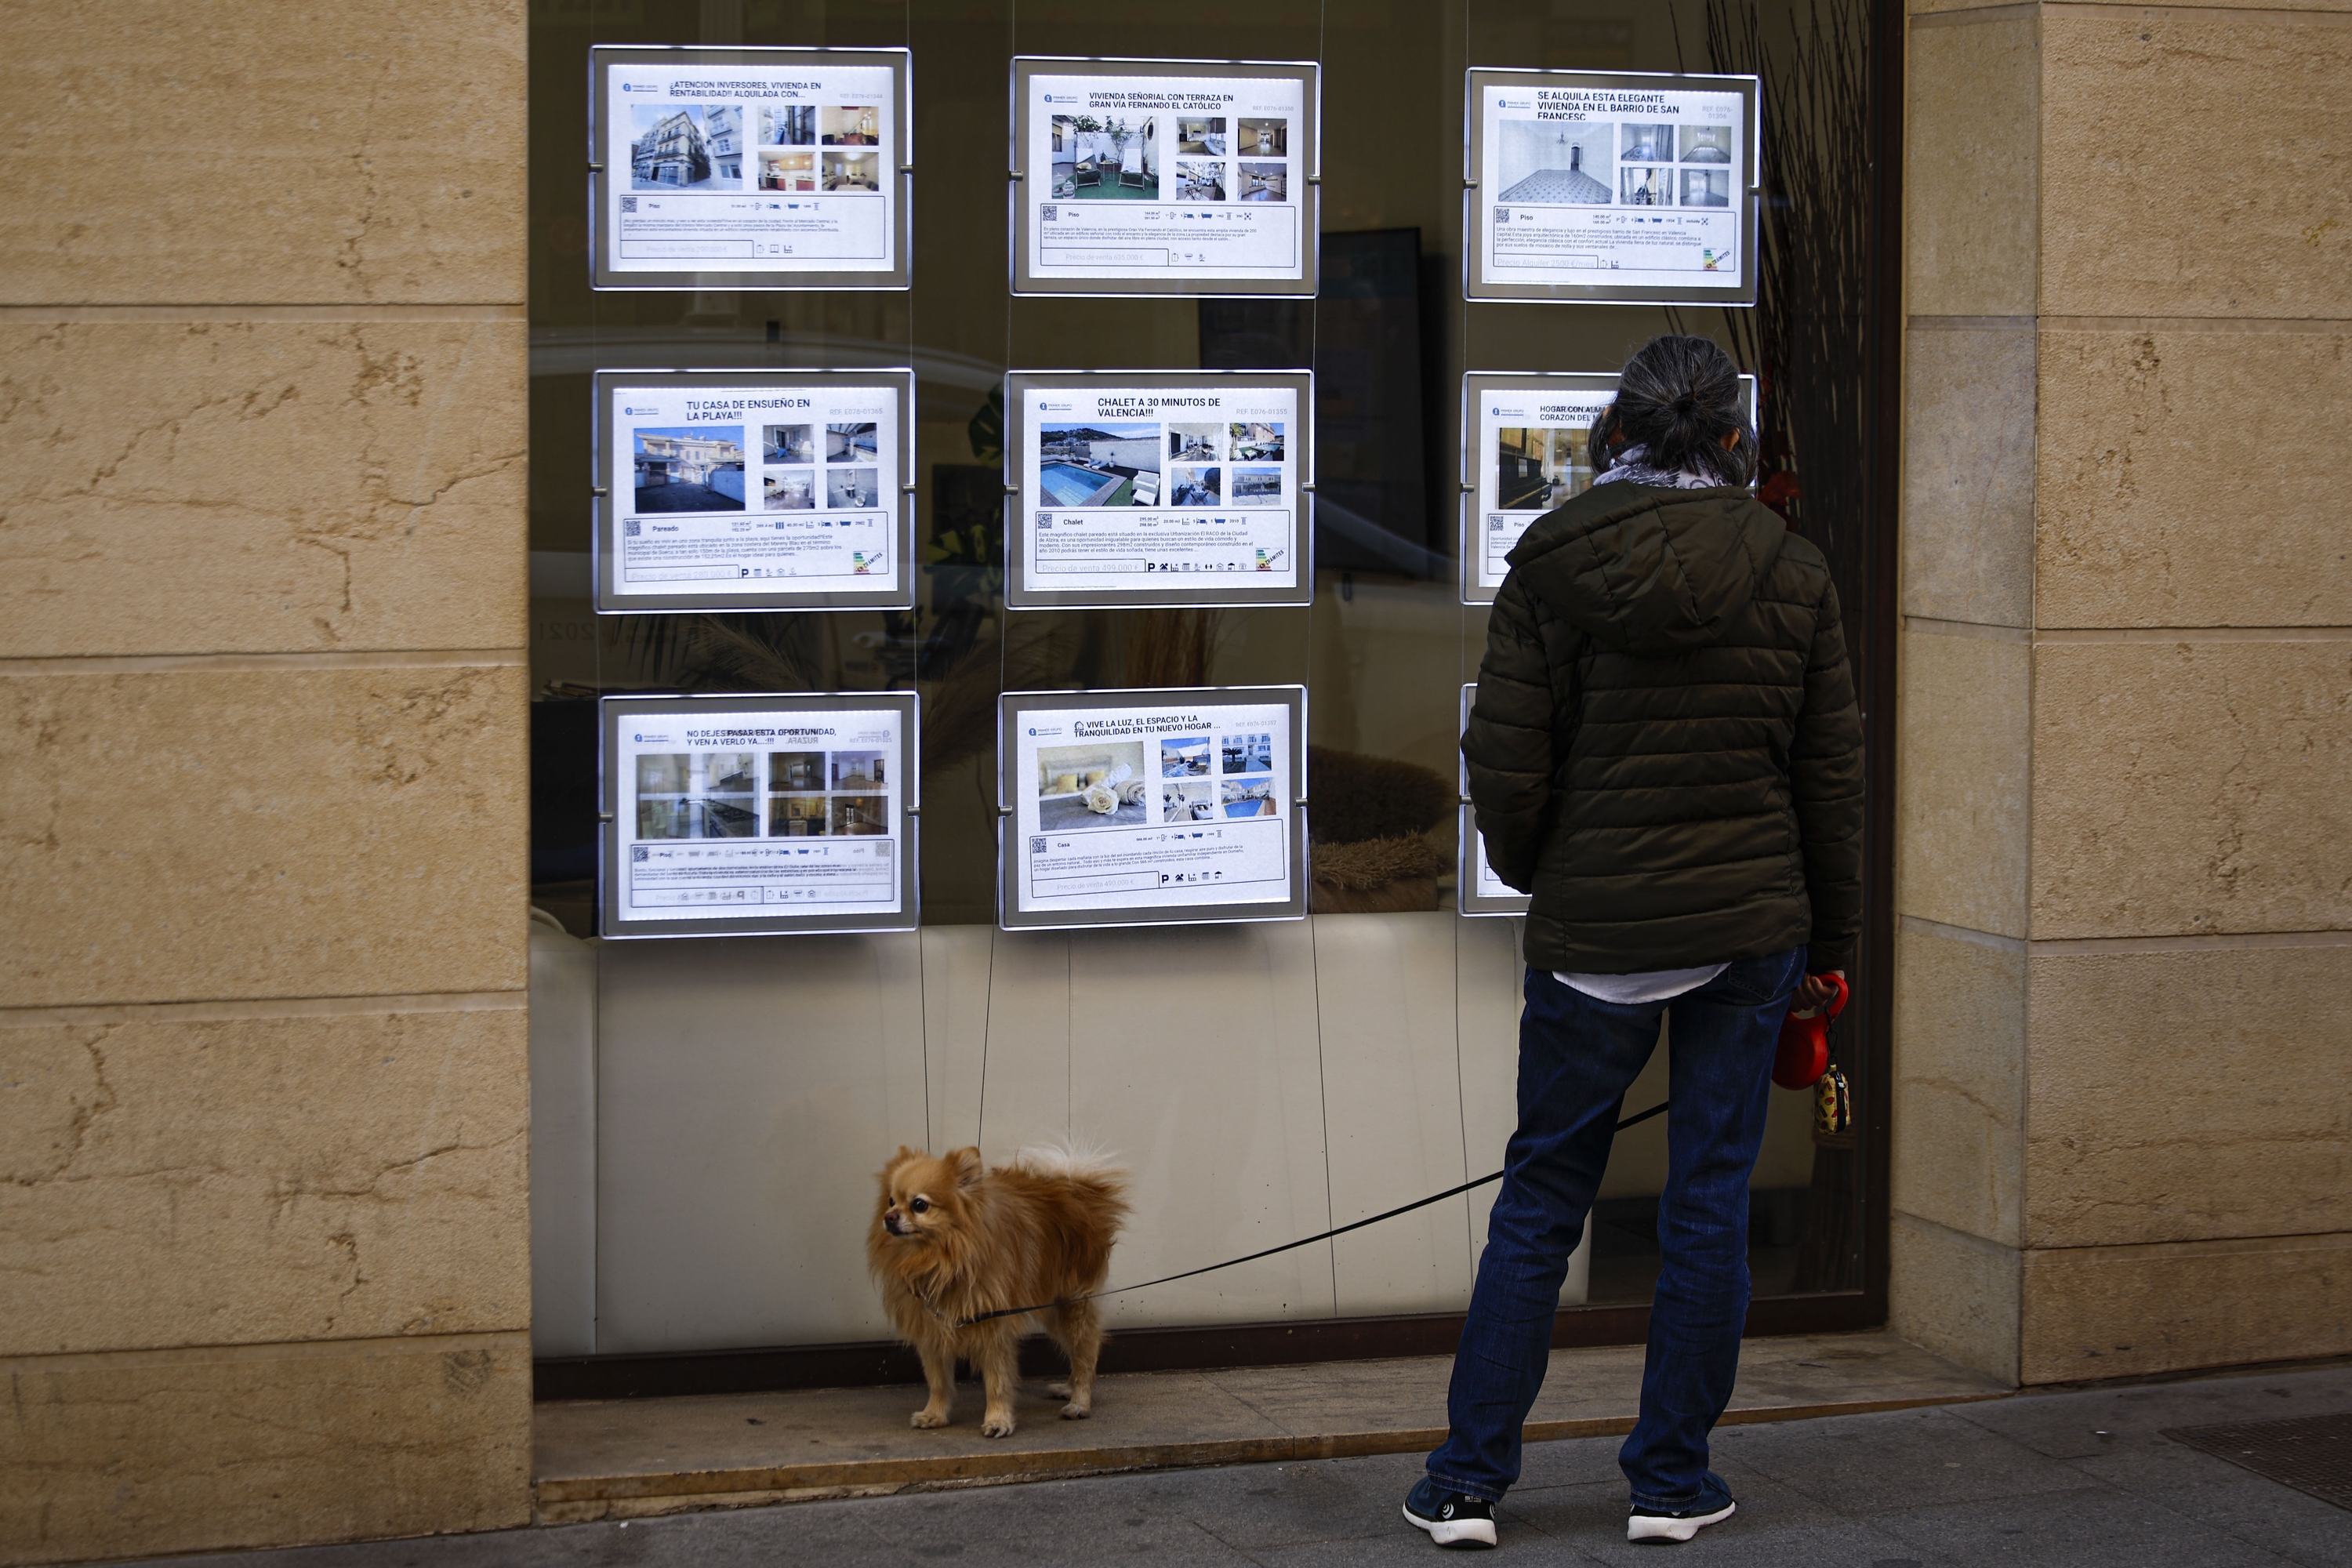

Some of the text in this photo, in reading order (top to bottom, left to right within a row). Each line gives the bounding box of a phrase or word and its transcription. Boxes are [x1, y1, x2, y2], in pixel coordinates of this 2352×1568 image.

[717, 82, 769, 90] INVERSORES,
[1089, 93, 1126, 101] VIVIENDA
[1185, 93, 1221, 102] TERRAZA
[1537, 91, 1664, 103] SE ALQUILA ESTA ELEGANTE
[1112, 100, 1127, 108] VÍA
[1183, 100, 1221, 110] CATÓLICO
[1537, 101, 1679, 114] VIVIENDA EN EL BARRIO DE SAN
[1537, 111, 1586, 121] FRANCESC
[1113, 252, 1138, 261] 635.000
[686, 397, 810, 410] TU CASA DE ENSUEÑO EN
[1098, 397, 1136, 407] CHALET
[1147, 397, 1159, 407] 30
[1161, 397, 1206, 407] MINUTOS
[1208, 397, 1221, 407] DE
[687, 412, 742, 421] LA PLAYA!!!
[1098, 408, 1153, 417] VALENCIA!!!
[1146, 716, 1179, 724] ESPACIO
[1074, 728, 1131, 738] TRANQUILIDAD
[1156, 724, 1183, 732] NUEVO
[1185, 722, 1212, 731] HOGAR
[1104, 878, 1129, 887] 490.000
